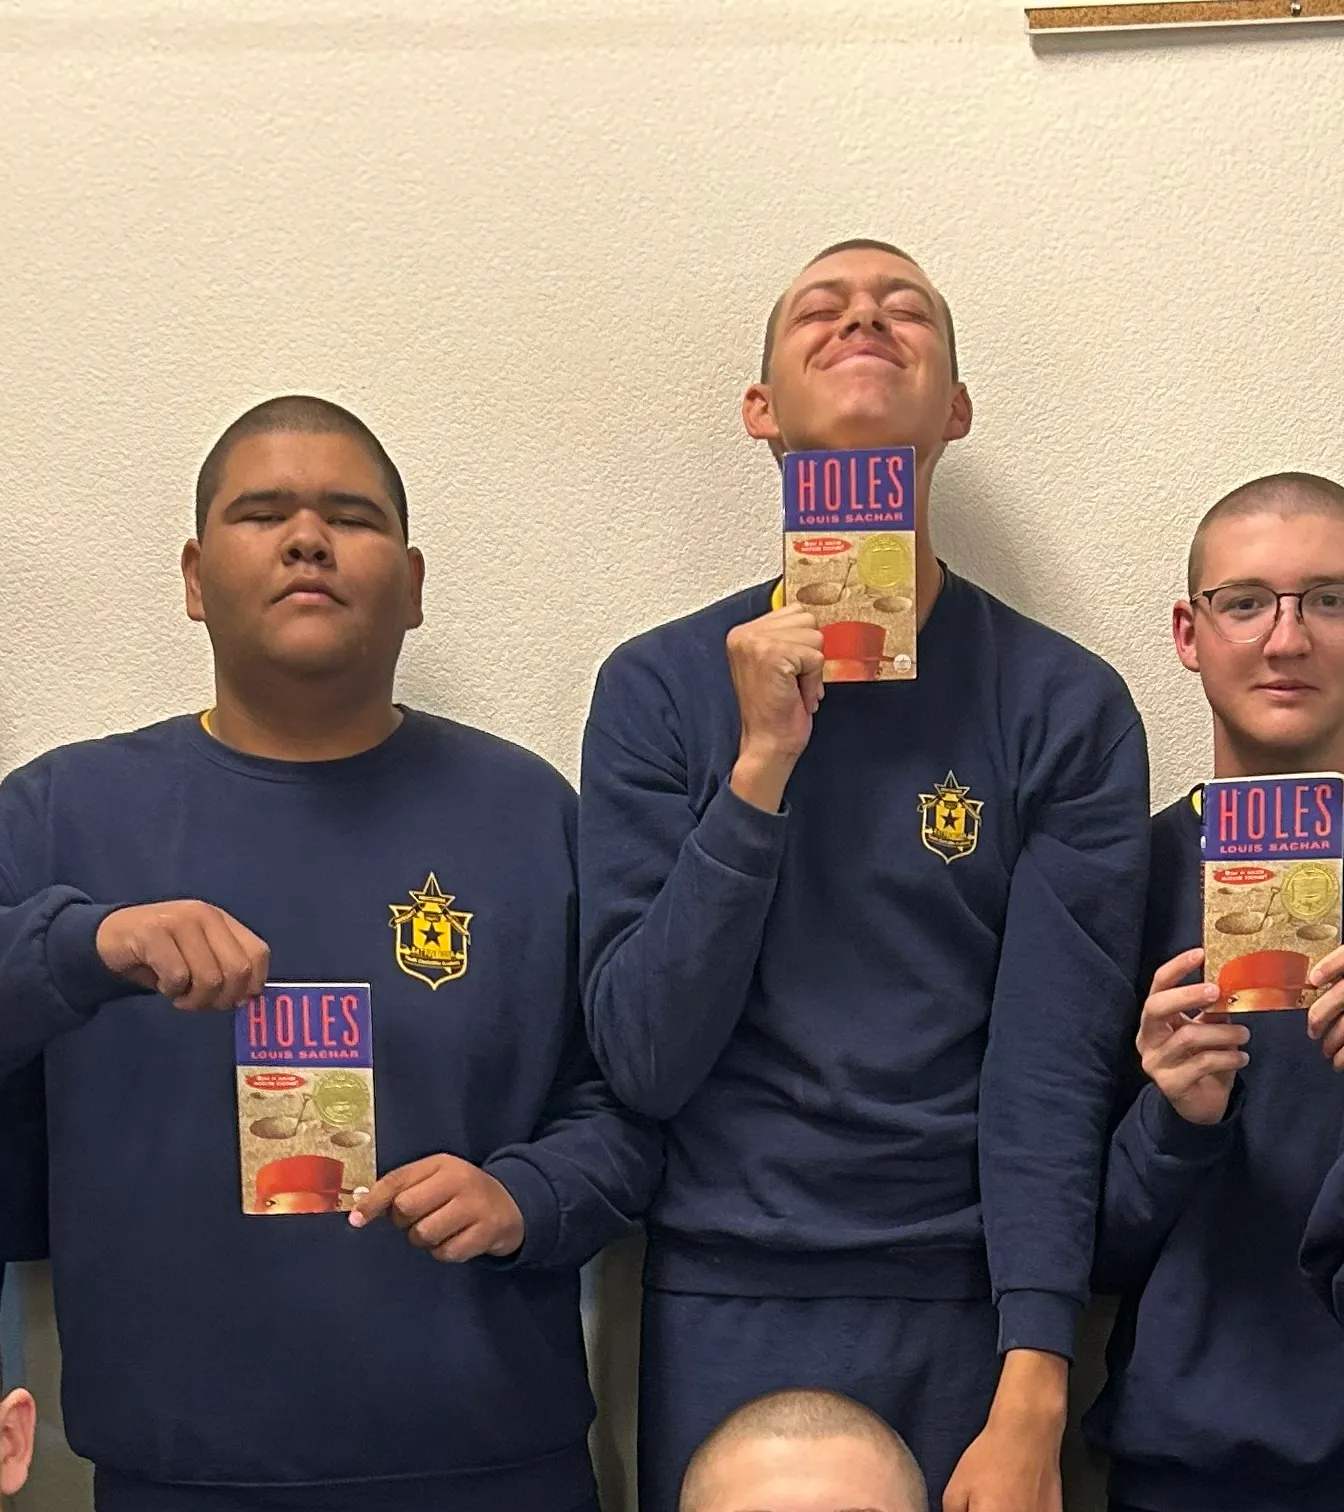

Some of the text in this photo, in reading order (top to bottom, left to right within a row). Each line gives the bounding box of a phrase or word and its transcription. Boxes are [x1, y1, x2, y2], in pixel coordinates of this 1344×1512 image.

[798, 456, 904, 512] HOLES
[799, 512, 904, 525] LOUIS SACHAR
[1218, 784, 1332, 842] HOLES
[1219, 840, 1331, 854] LOUIS SACHAR
[248, 994, 360, 1048] HOLES
[250, 1049, 360, 1060] LOUIS SACHAR
